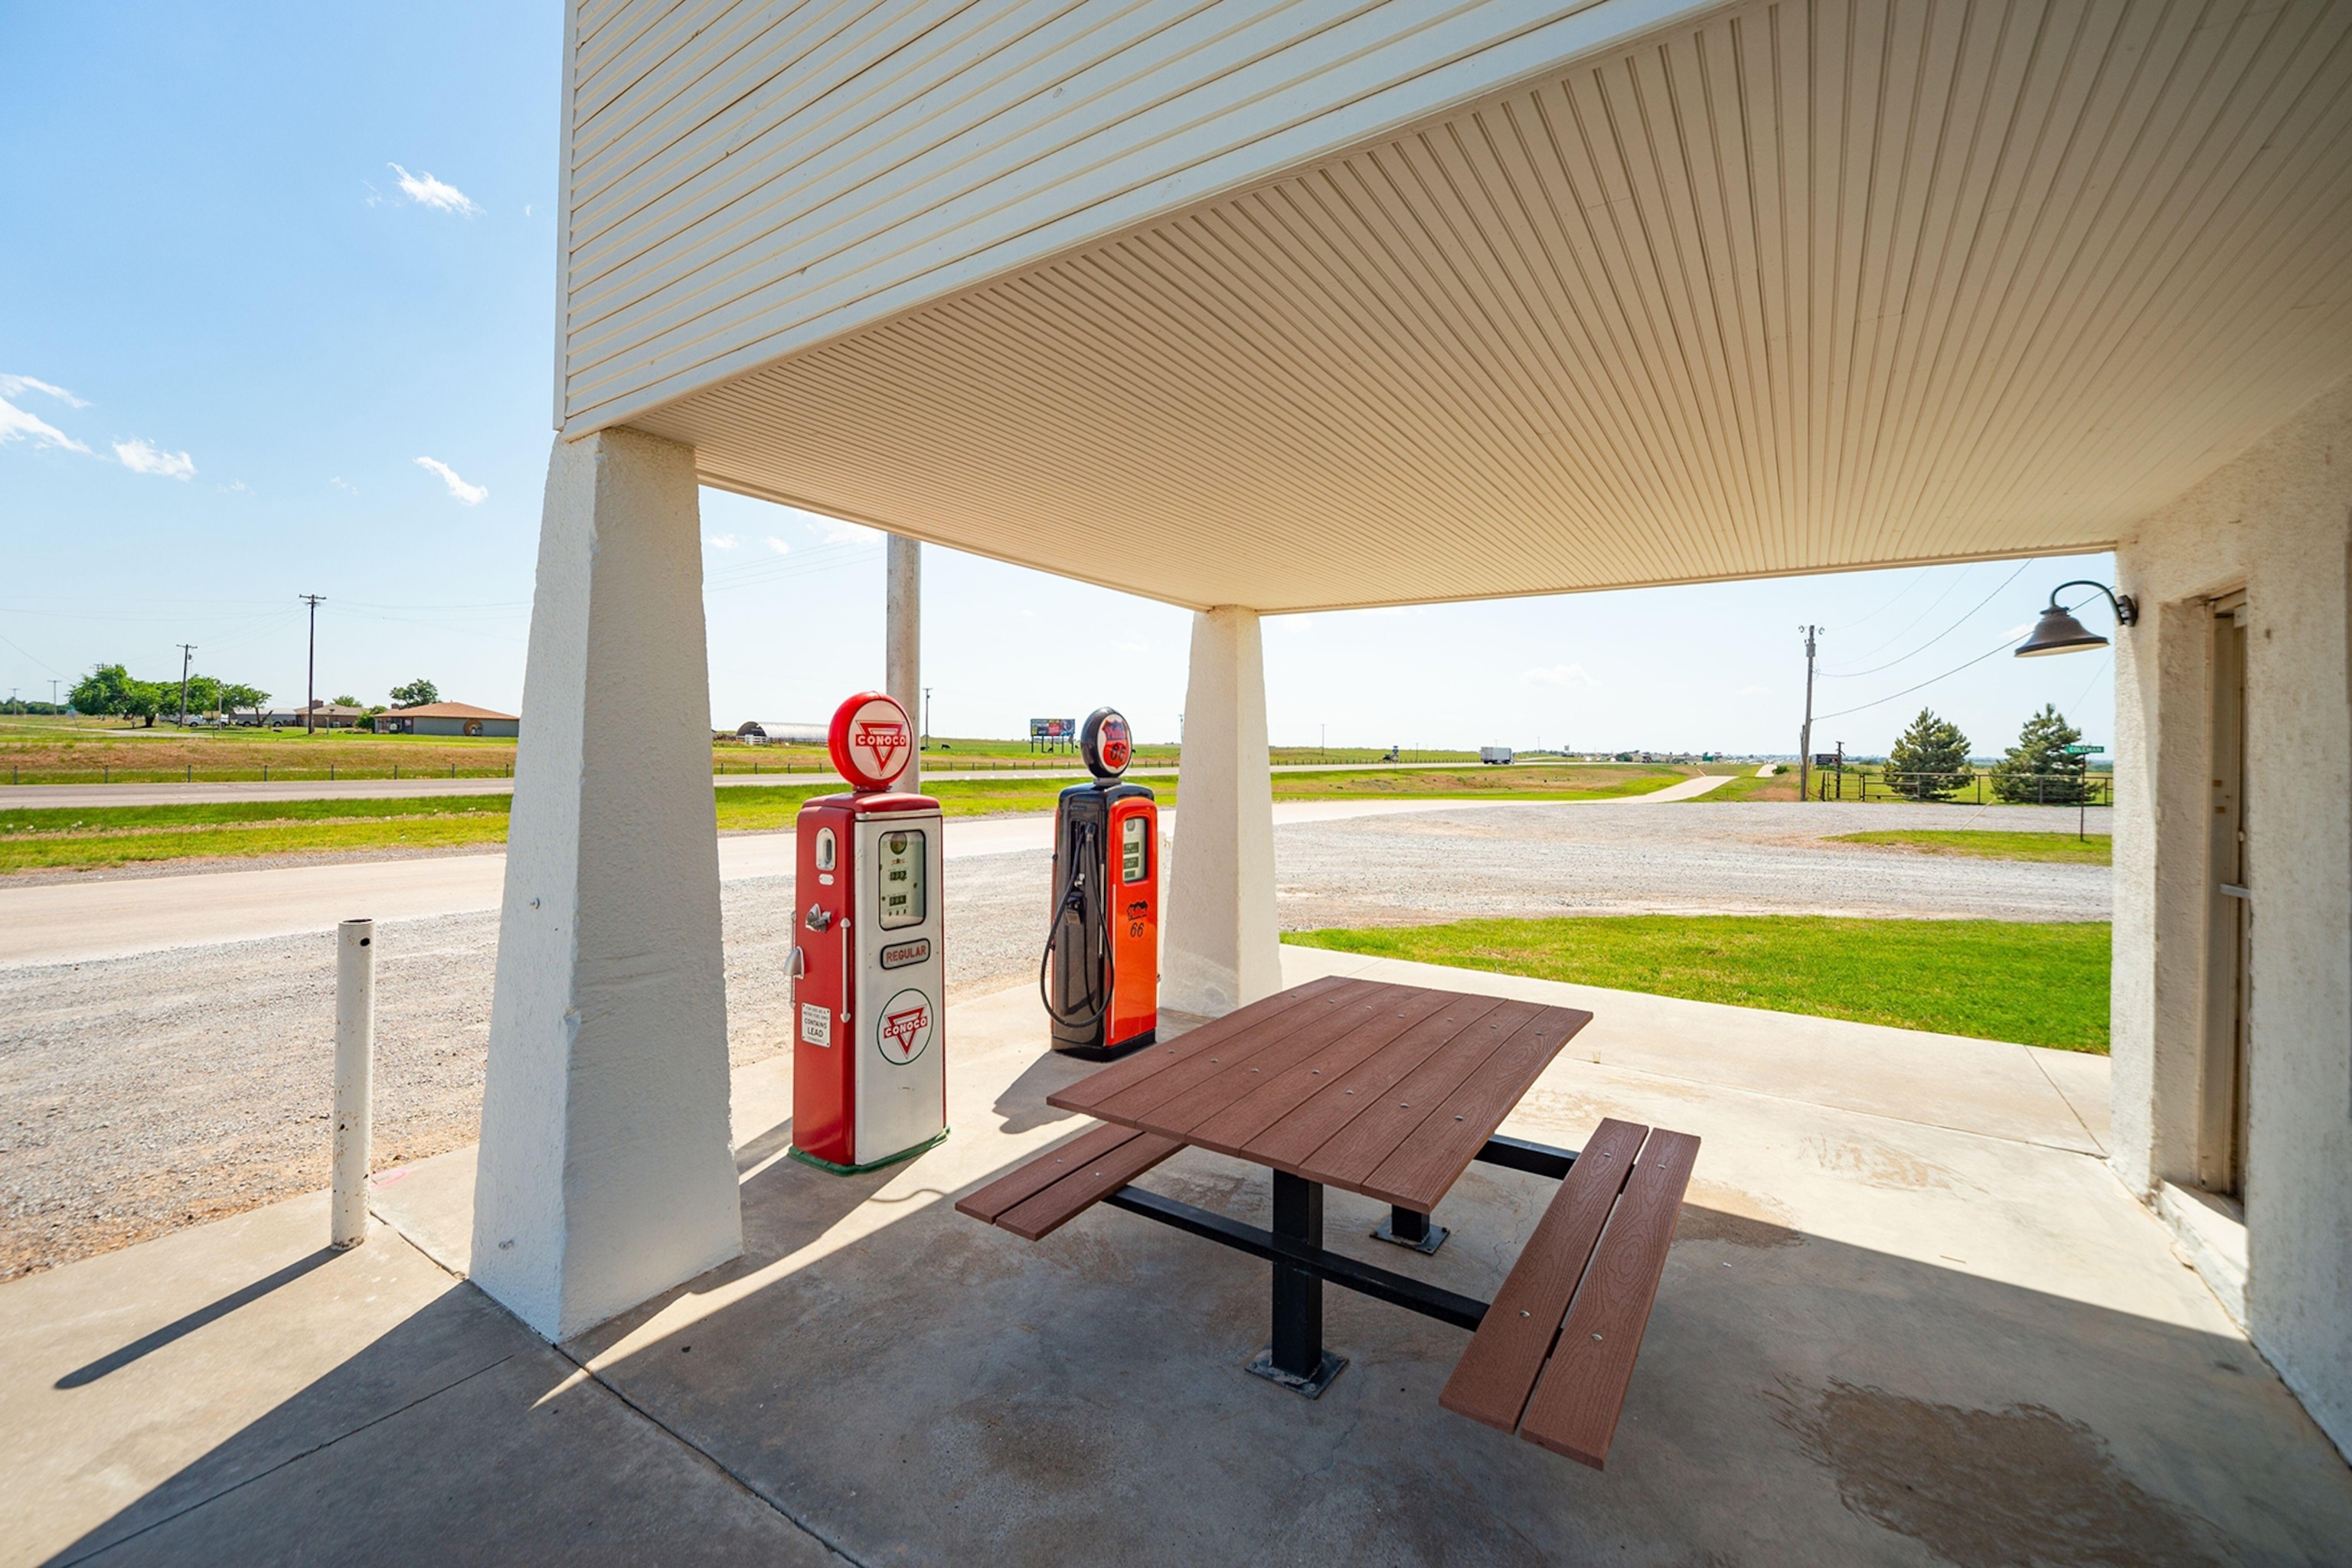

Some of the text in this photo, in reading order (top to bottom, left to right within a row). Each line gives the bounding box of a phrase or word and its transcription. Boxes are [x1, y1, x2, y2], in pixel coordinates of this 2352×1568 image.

[857, 735, 906, 746] CONOCO
[1110, 743, 1126, 763] 66
[1130, 922, 1145, 938] 66
[886, 945, 926, 962] REGULAR
[804, 1018, 827, 1029] CONTAINS
[884, 1017, 927, 1036] CONOCO
[807, 1027, 824, 1037] LEAD
